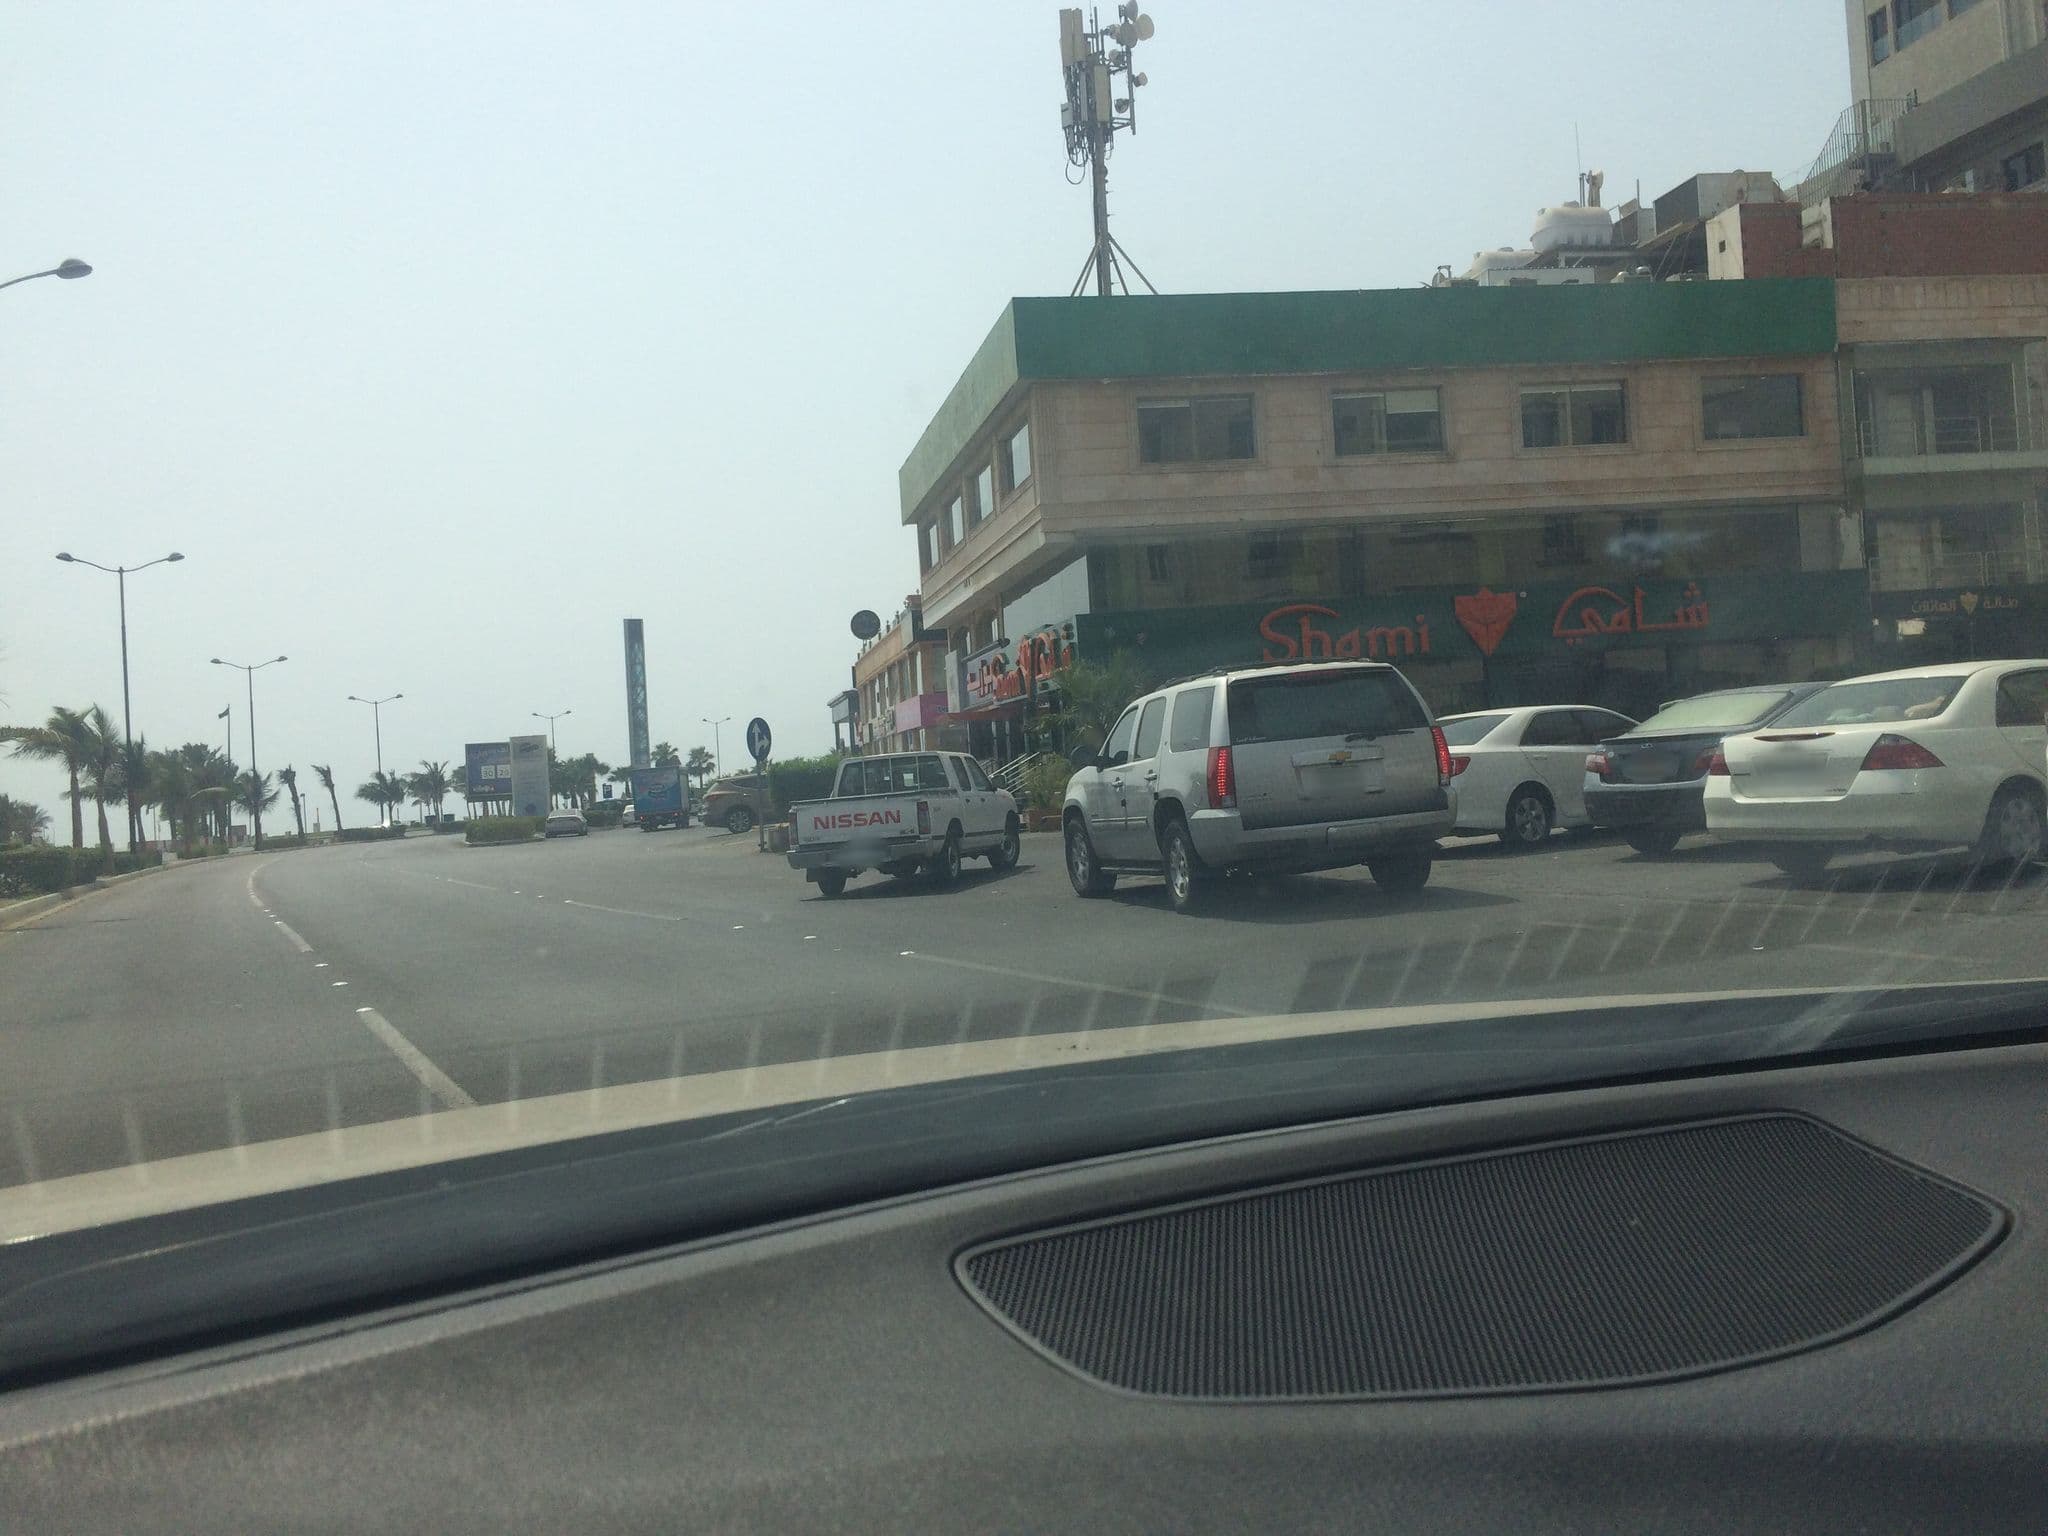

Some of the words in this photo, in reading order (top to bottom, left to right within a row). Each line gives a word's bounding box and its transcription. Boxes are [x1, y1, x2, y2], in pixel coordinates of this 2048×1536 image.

[1260, 604, 1430, 661] Shami
[1552, 582, 1709, 646] شامي
[813, 810, 900, 830] NISSAN
